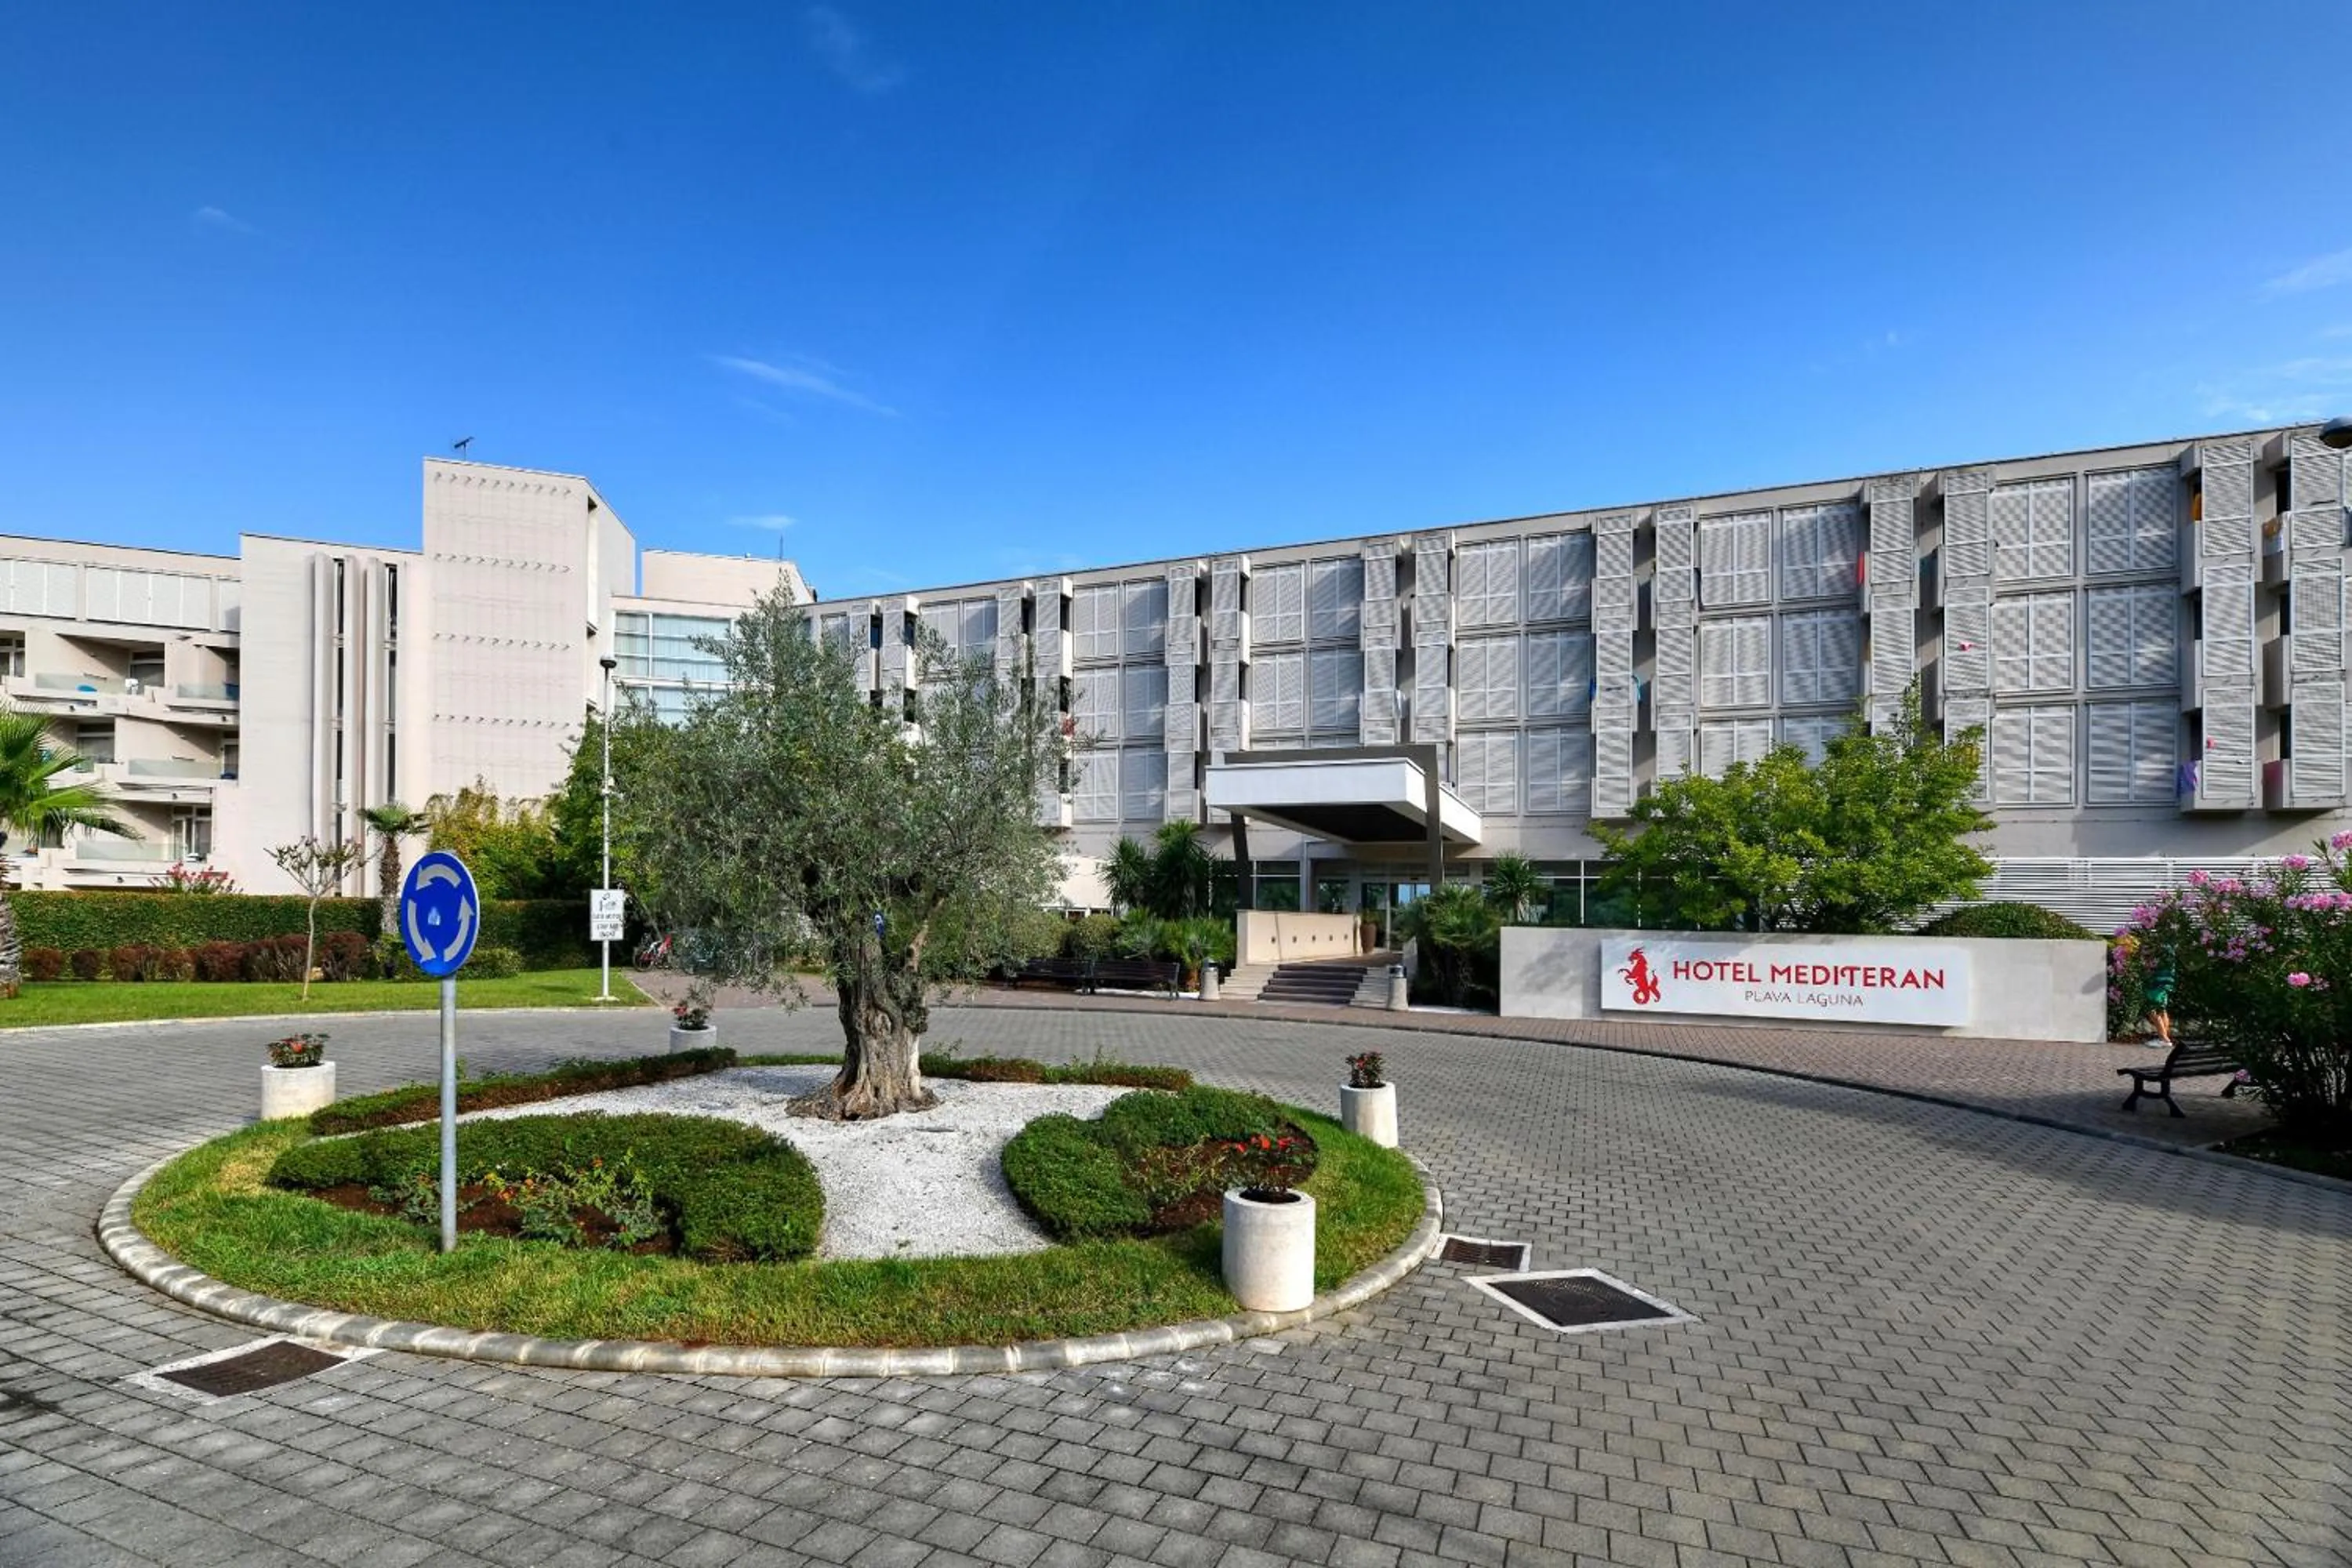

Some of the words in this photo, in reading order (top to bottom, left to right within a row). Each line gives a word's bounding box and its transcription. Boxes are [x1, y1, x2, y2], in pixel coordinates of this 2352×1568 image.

[1673, 961, 1761, 982] HOTEL
[1770, 965, 1944, 989] MEDITERAN
[1745, 990, 1791, 1003] PLAVA
[1798, 993, 1864, 1007] LAGUNA
